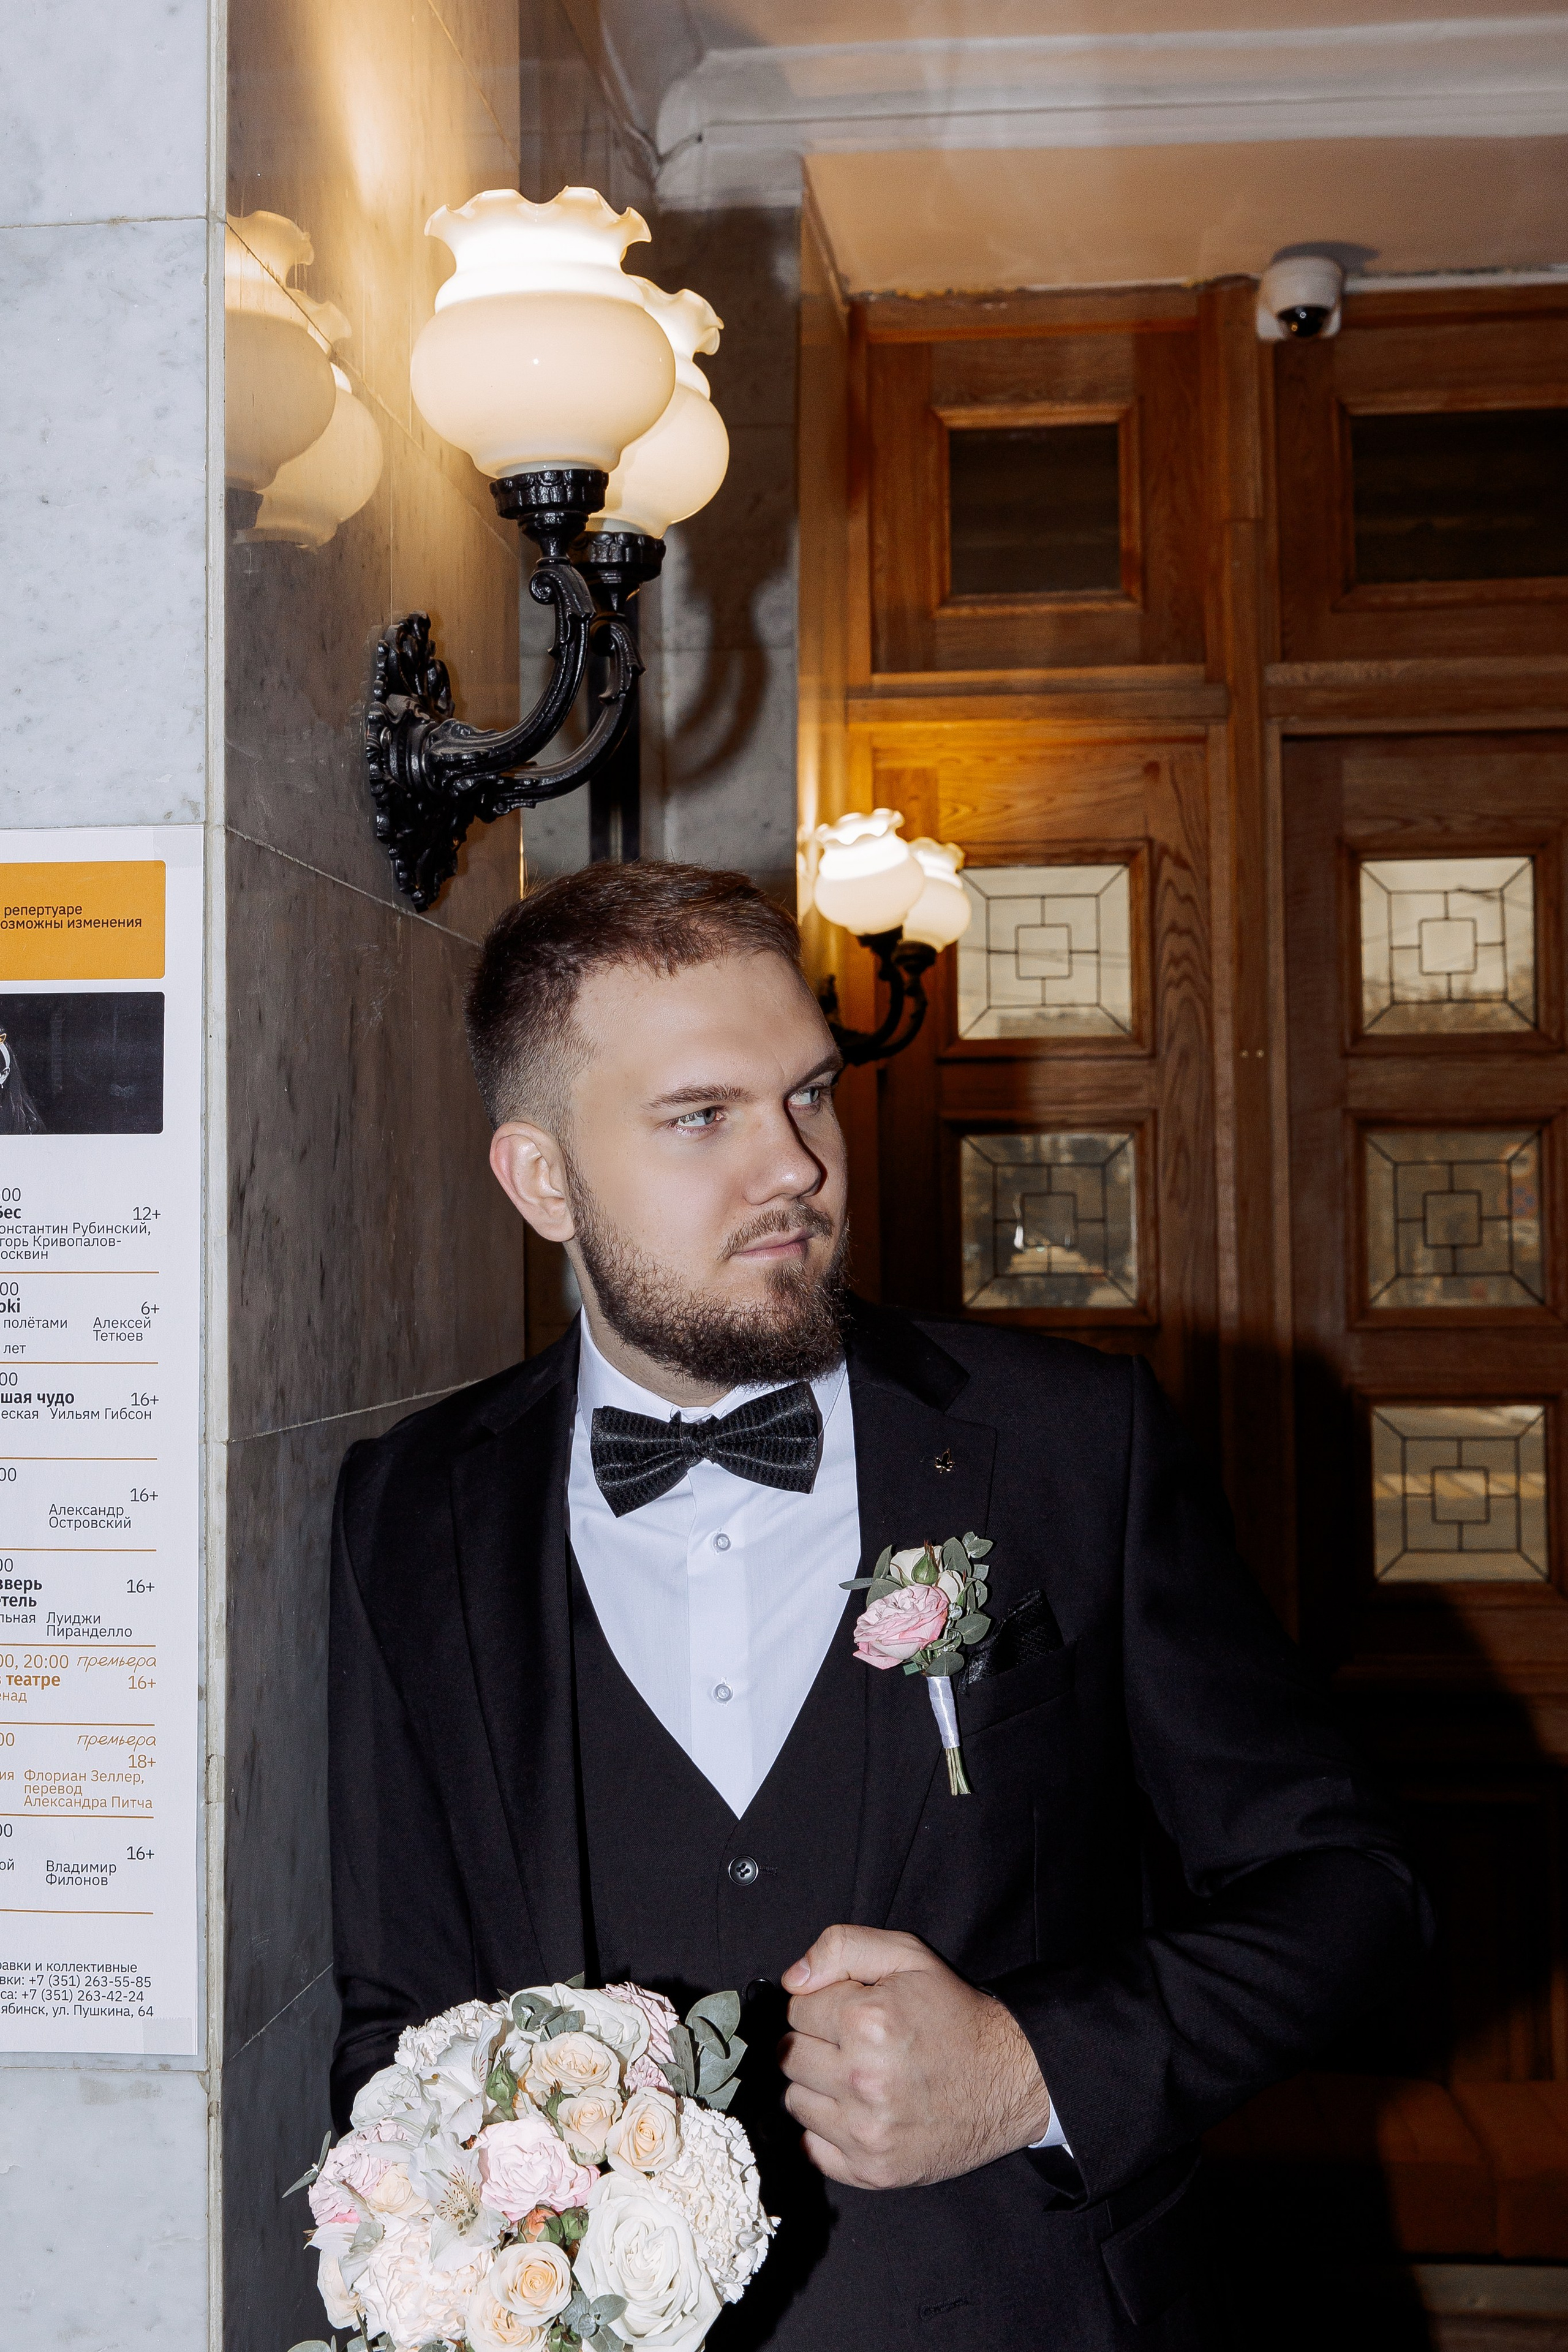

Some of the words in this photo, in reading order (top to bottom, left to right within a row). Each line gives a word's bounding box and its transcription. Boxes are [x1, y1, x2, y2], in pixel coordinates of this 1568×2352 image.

[4, 906, 82, 918] репертуаре
[1, 920, 62, 929] озможны
[68, 919, 141, 928] изменения
[133, 1207, 160, 1220] 12+
[0, 1225, 67, 1234] онстантин
[73, 1222, 150, 1237] Рубинский,
[34, 1235, 121, 1250] Кривопалов-
[1, 1251, 48, 1259] осквин
[141, 1302, 159, 1315] 6+
[4, 1317, 67, 1328] полётами
[93, 1317, 151, 1329] Алексей
[93, 1330, 143, 1341] Тетюев
[3, 1345, 26, 1354] лет
[1, 1393, 31, 1403] шая
[37, 1393, 74, 1408] чудо
[131, 1392, 159, 1406] 16+
[1, 1410, 38, 1419] еская
[50, 1408, 99, 1419] Уильям
[105, 1408, 151, 1420] Гибсон
[130, 1488, 158, 1502] 16+
[49, 1504, 124, 1519] Александр
[50, 1515, 130, 1531] Островский
[127, 1580, 154, 1593] 16+
[0, 1596, 37, 1607] тель
[46, 1612, 100, 1627] Луиджи
[47, 1625, 132, 1640] Пиранделло
[24, 1654, 68, 1668] 20:00
[77, 1657, 156, 1673] премьера
[6, 1675, 60, 1690] театре
[129, 1676, 156, 1689] 16+
[0, 1692, 27, 1703] над
[77, 1735, 156, 1752] премьера
[129, 1755, 156, 1768] 18+
[24, 1769, 86, 1784] Флориан
[91, 1770, 143, 1785] Зеллер,
[24, 1785, 82, 1796] перевод
[24, 1795, 107, 1810] Александра
[112, 1796, 153, 1808] Питча
[127, 1846, 154, 1860] 16+
[47, 1860, 116, 1877] Владимир
[46, 1873, 108, 1885] Филонов
[0, 1962, 31, 1970] авки
[47, 1963, 137, 1973] коллективные
[29, 1975, 43, 1986] +7
[49, 1974, 80, 1988] (351)
[85, 1976, 151, 1988] 263-55-85
[22, 1989, 37, 2000] +7
[42, 1988, 72, 2003] (351)
[78, 1990, 144, 2002] 263-42-24
[1, 2002, 48, 2016] ябинск,
[52, 2007, 69, 2018] ул.
[74, 2005, 134, 2018] Пушкина,
[138, 2006, 154, 2016] 64
